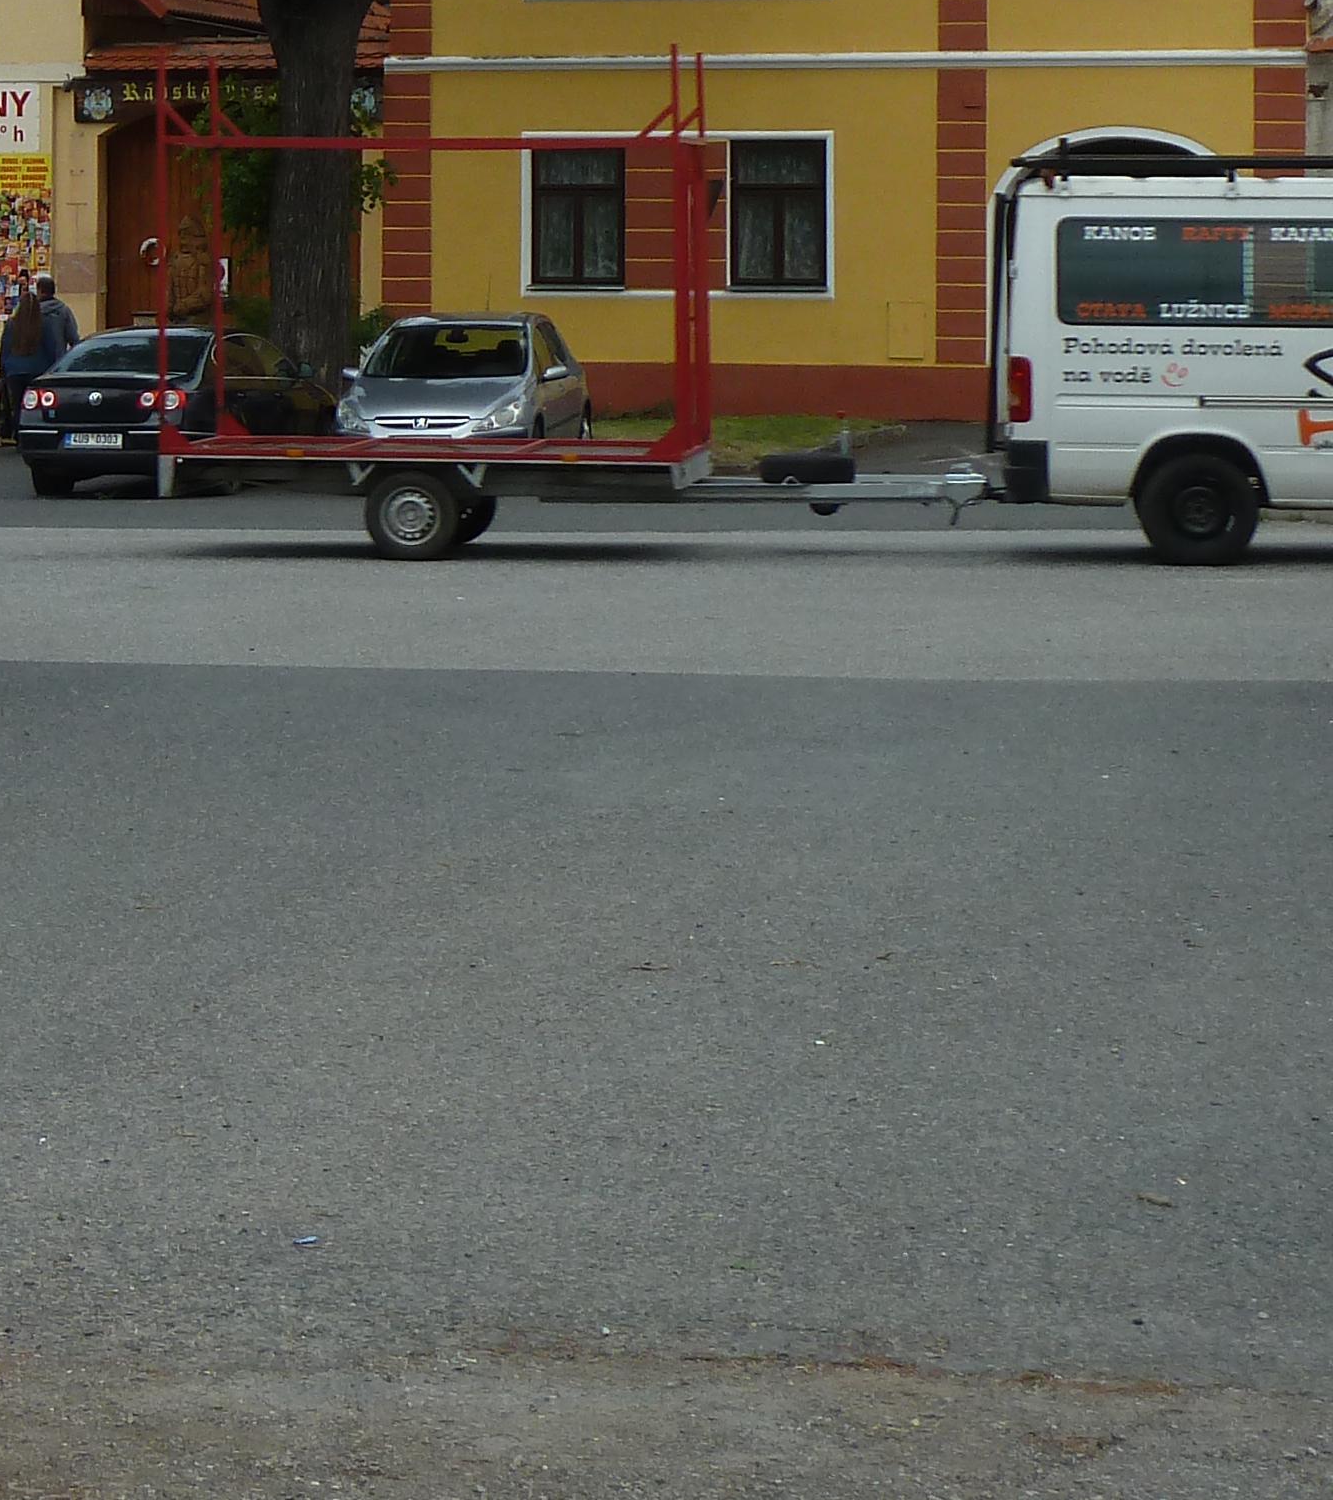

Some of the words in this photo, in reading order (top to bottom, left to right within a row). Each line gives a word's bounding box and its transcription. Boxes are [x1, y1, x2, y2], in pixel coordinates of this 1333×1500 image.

[13, 125, 24, 143] h
[1159, 299, 1251, 318] LUŽNICE
[1063, 337, 1174, 355] Pohodová
[1181, 339, 1284, 357] dovolená
[1063, 370, 1091, 383] na
[1099, 366, 1152, 384] vodě
